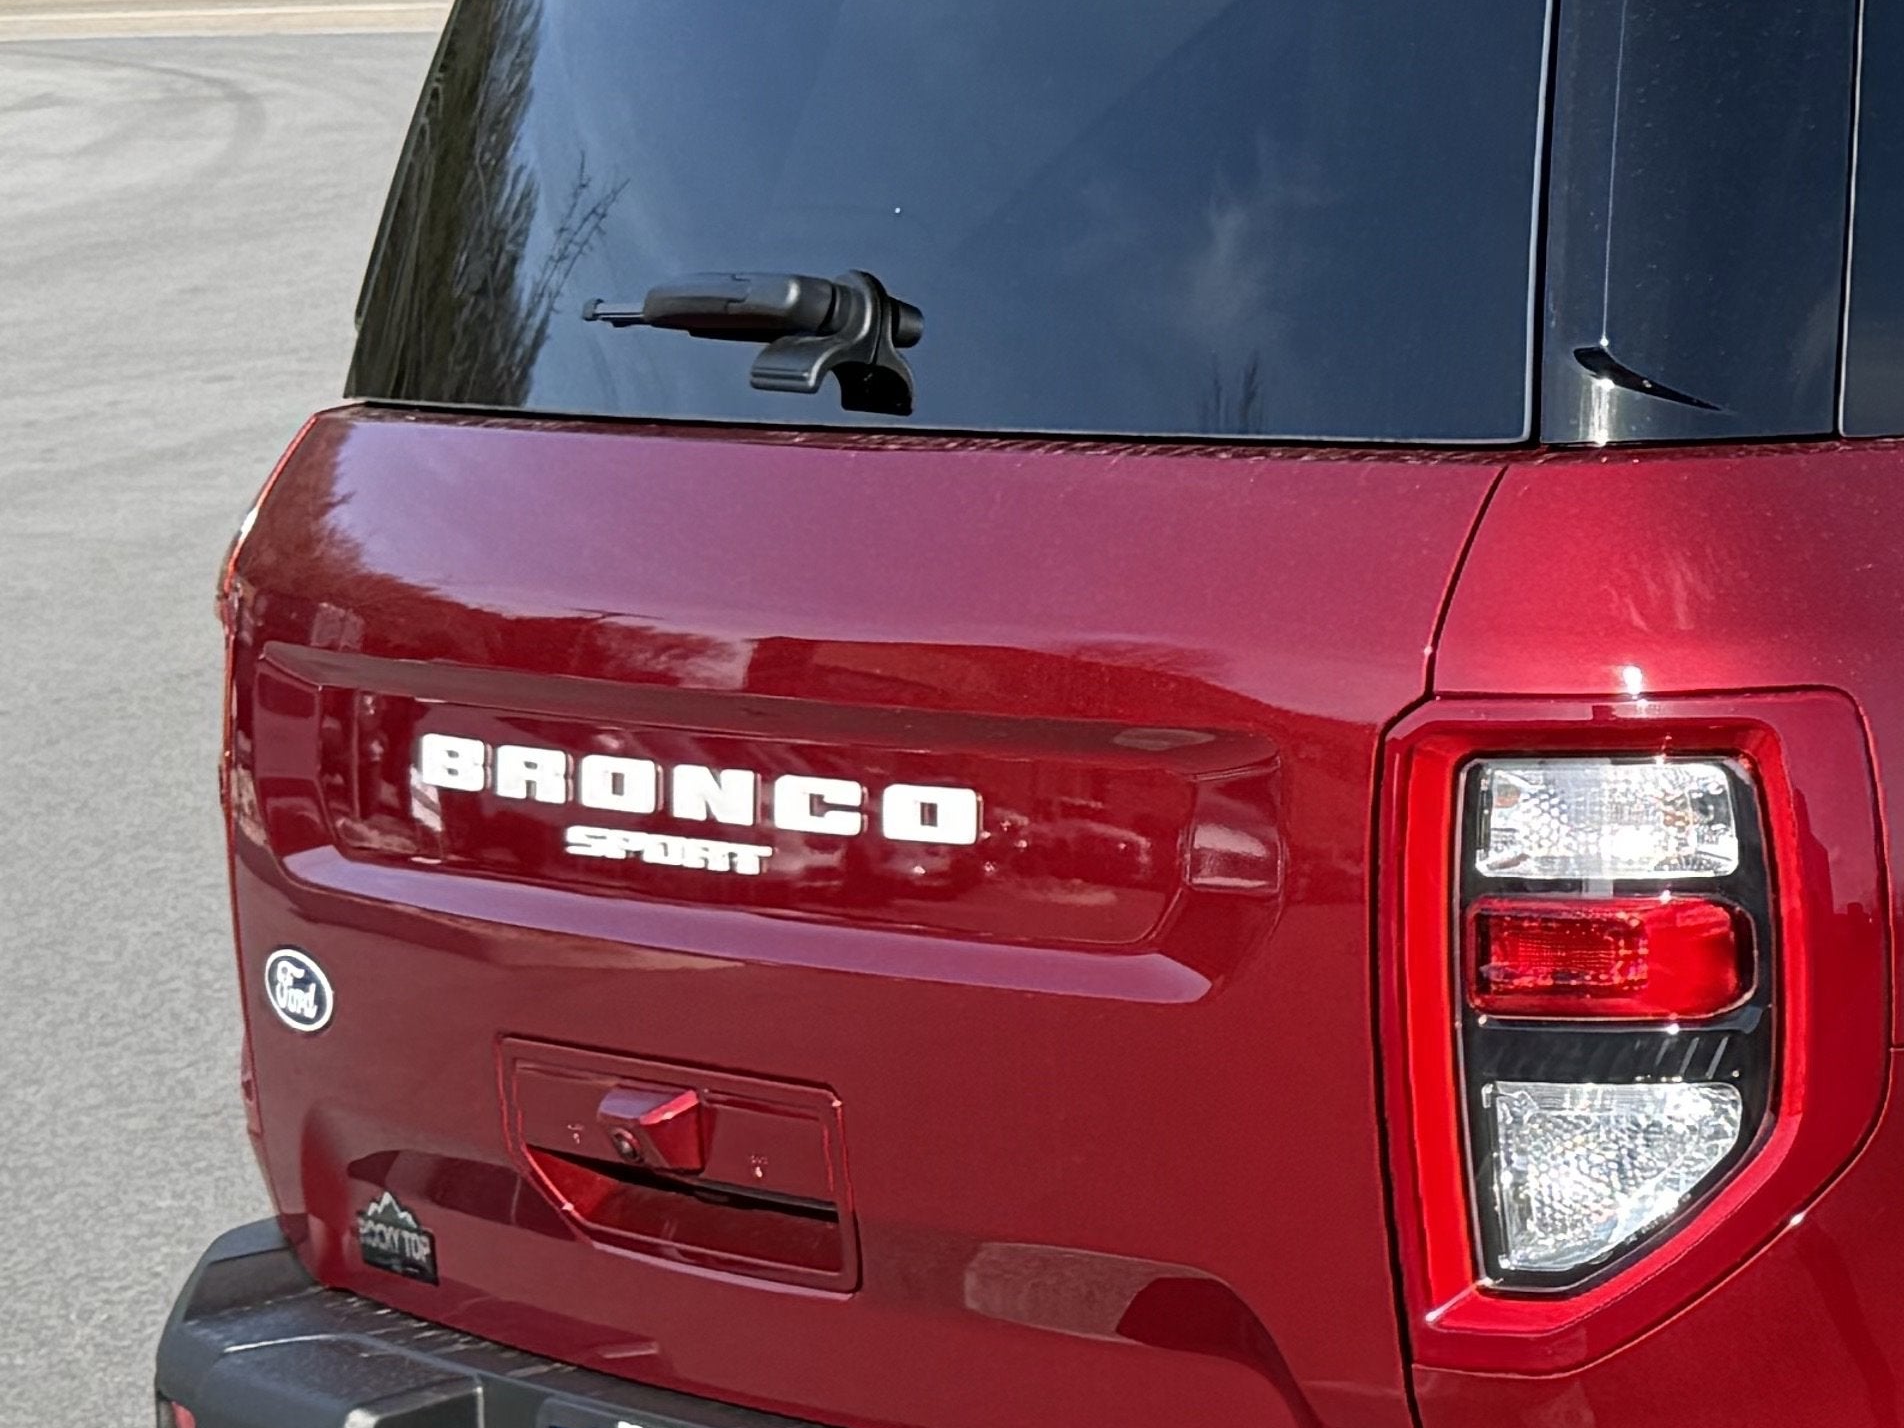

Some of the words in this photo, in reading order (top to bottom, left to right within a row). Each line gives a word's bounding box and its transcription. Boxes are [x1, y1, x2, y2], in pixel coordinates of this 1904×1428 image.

[419, 732, 983, 846] BRONCO
[564, 824, 773, 876] SPORT
[275, 959, 319, 1020] Ford
